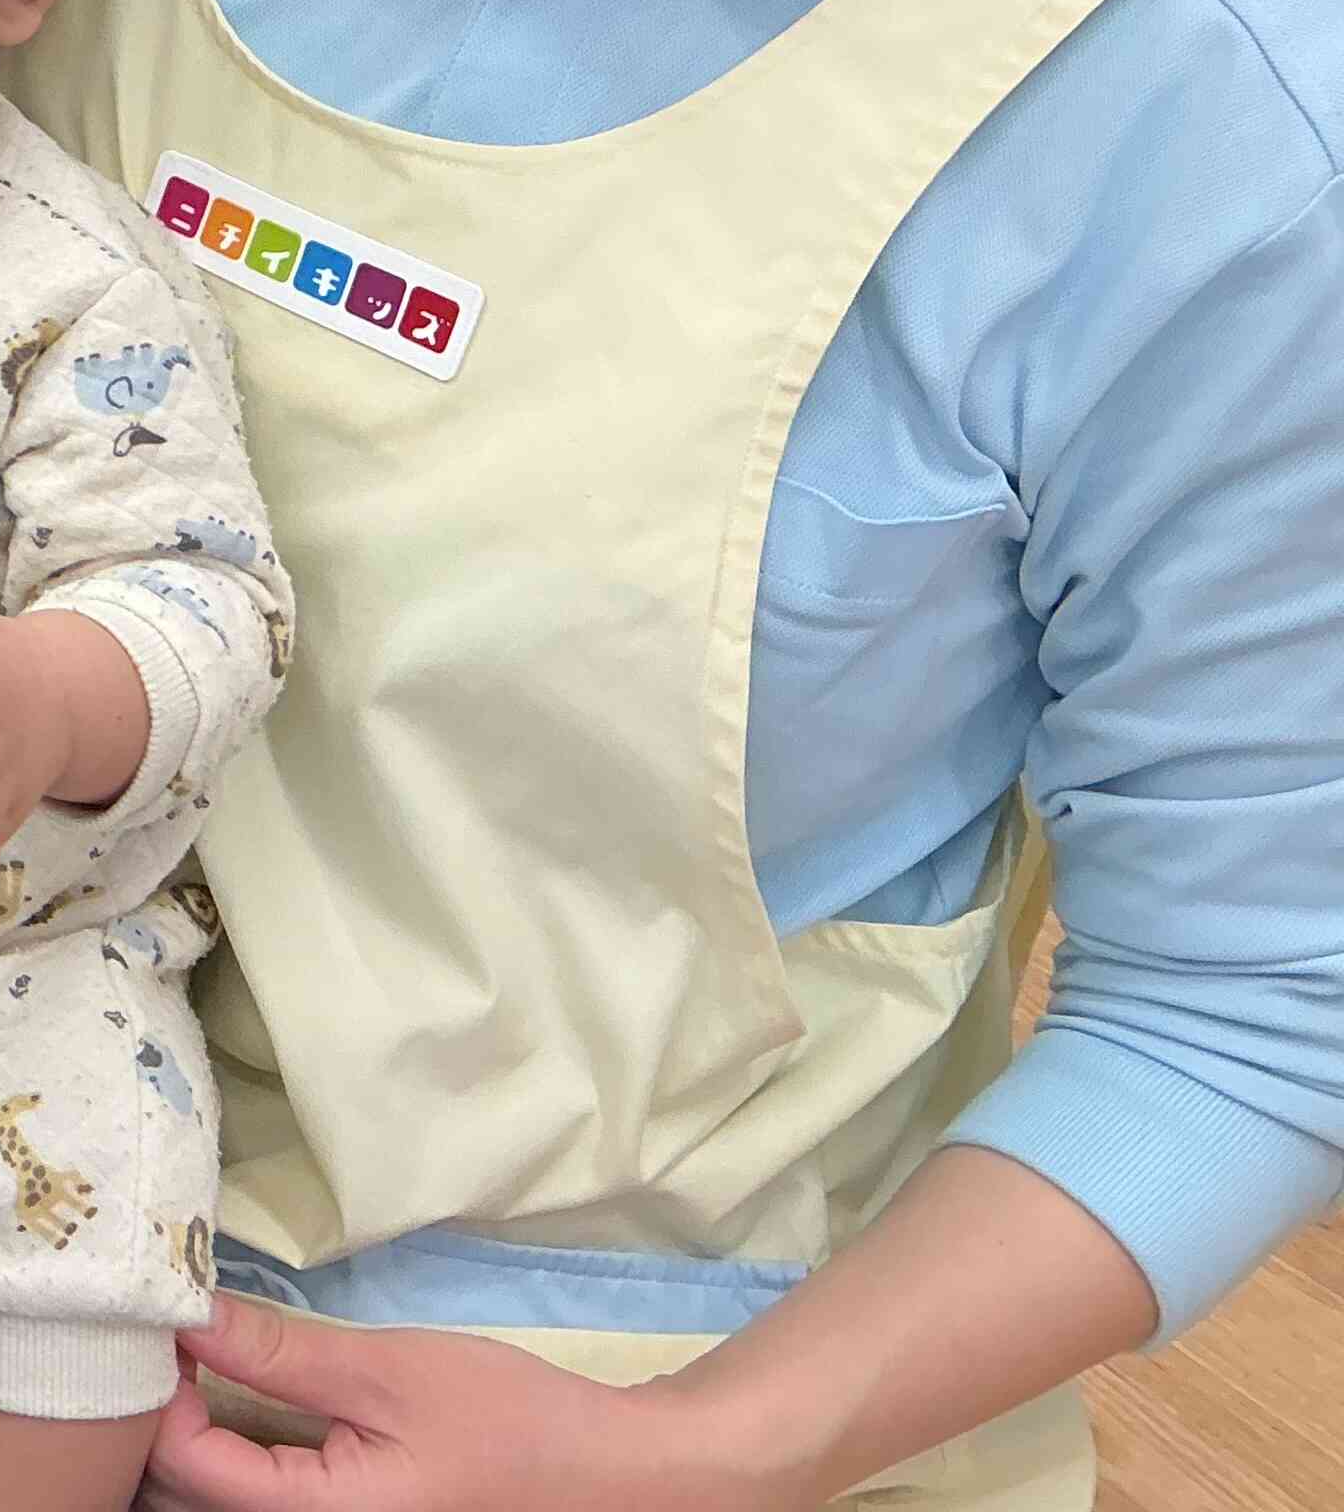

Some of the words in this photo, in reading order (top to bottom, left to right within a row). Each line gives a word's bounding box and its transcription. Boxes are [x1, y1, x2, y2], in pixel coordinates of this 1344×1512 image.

[169, 201, 452, 347] ニチイキッズ
